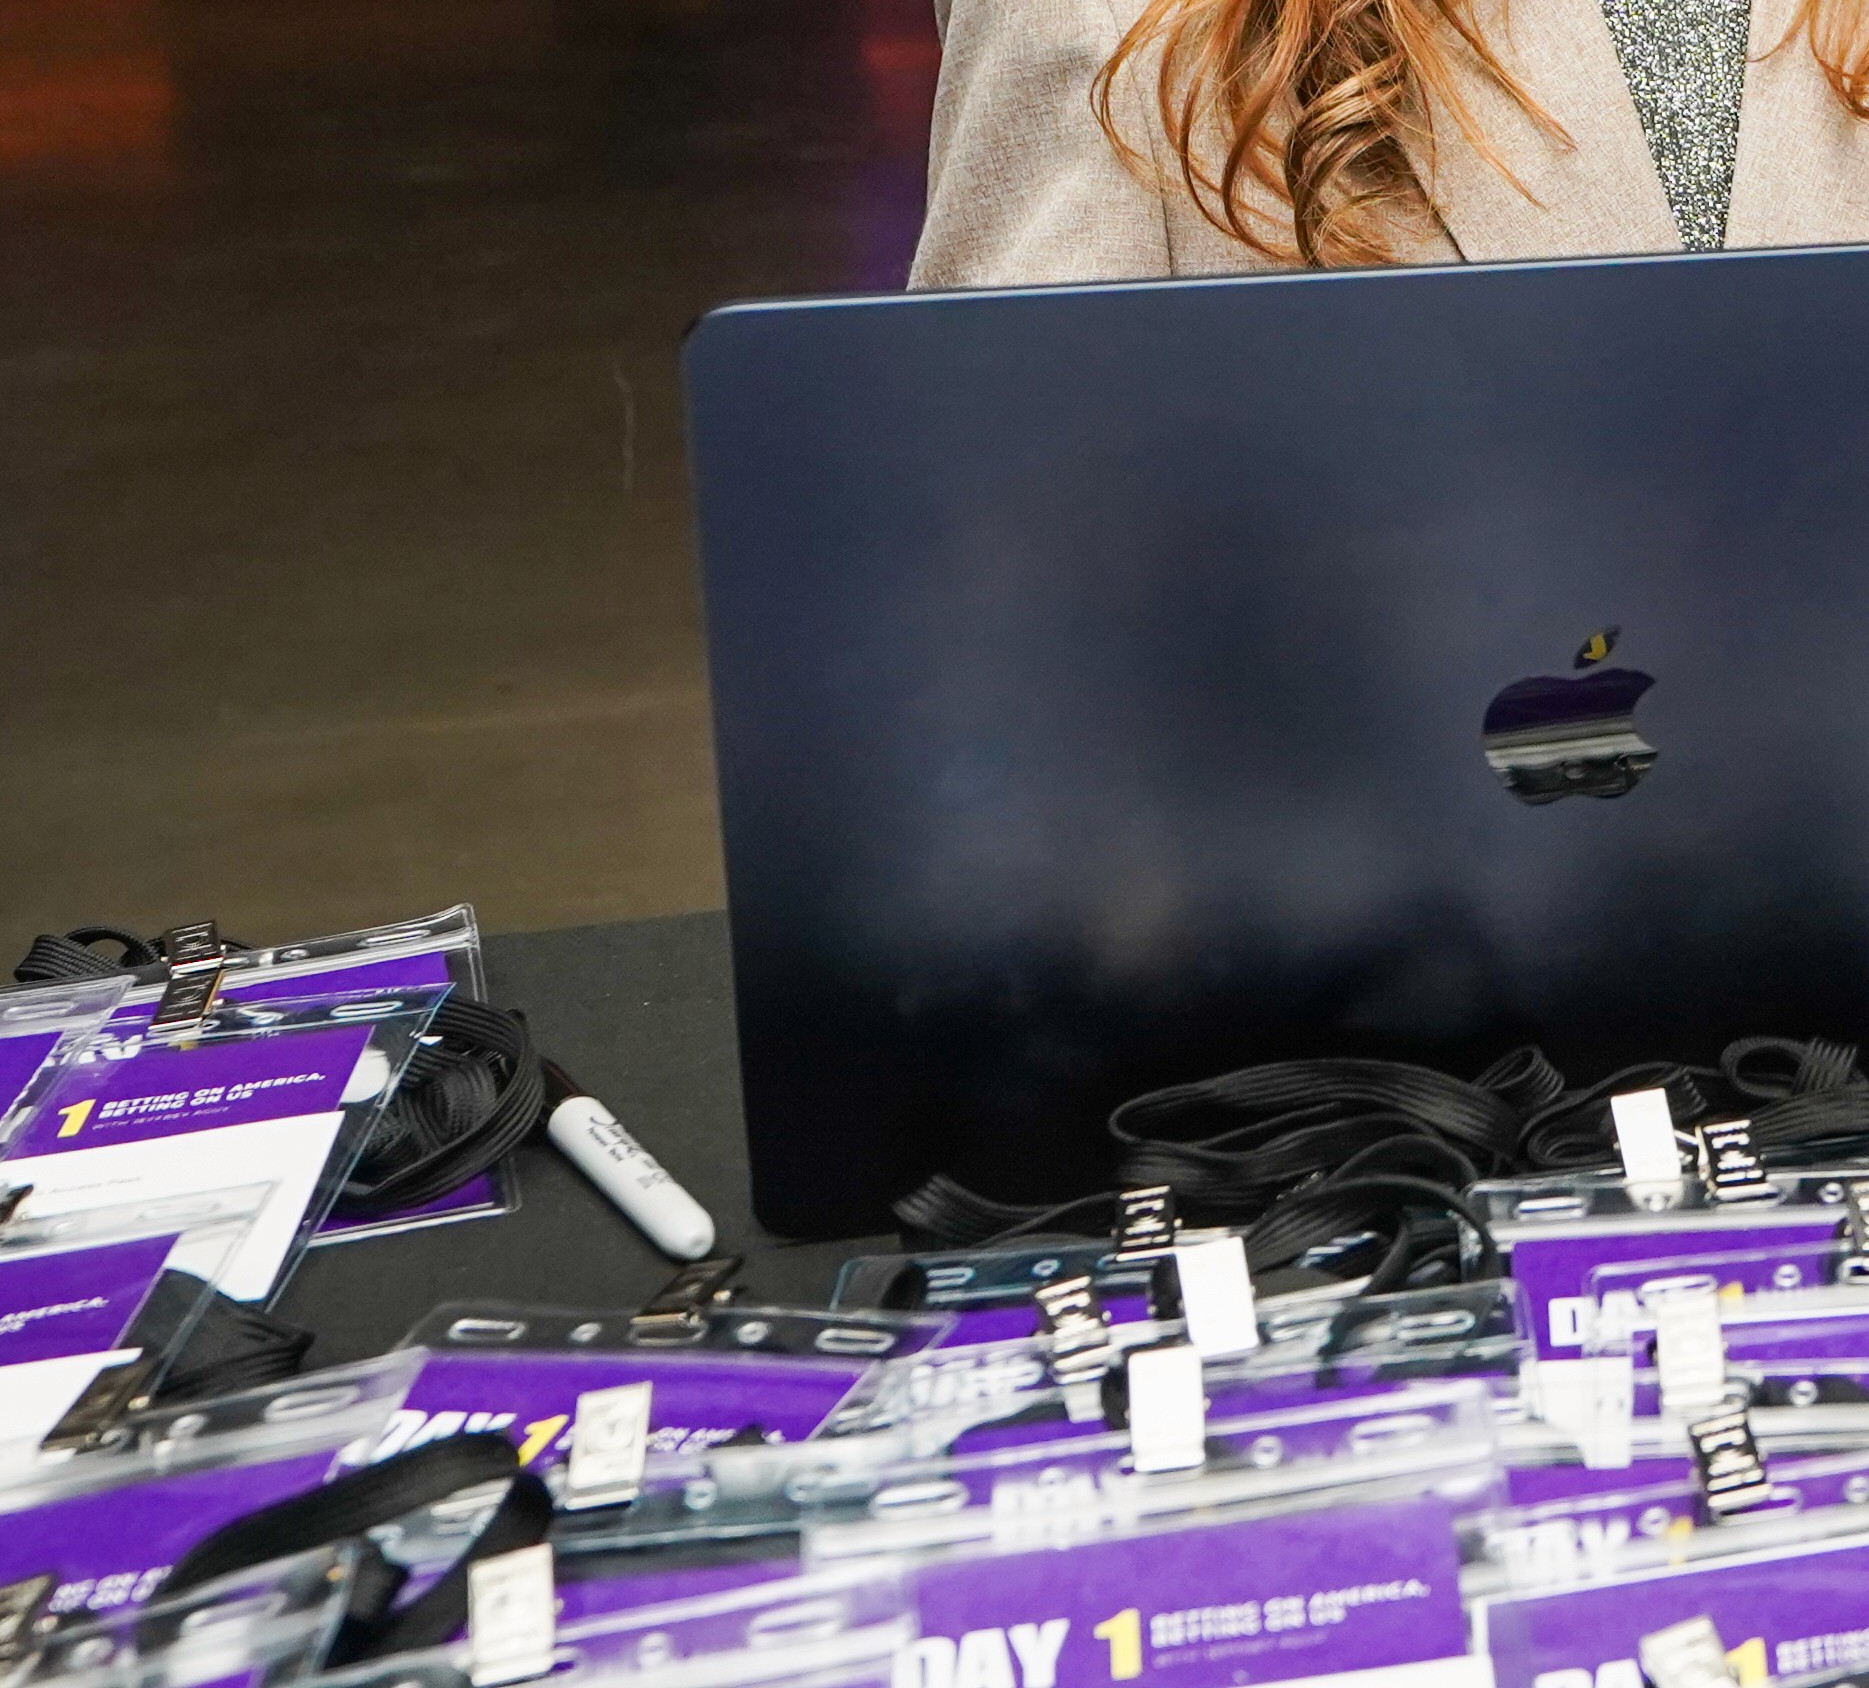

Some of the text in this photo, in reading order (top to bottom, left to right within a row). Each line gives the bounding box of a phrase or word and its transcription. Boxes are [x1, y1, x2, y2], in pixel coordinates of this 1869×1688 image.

[98, 1089, 255, 1119] BETTING ON US
[103, 1072, 326, 1110] BETTING ON AMERICA,
[57, 1099, 96, 1138] 1
[889, 1617, 1071, 1688] DAY
[1093, 1607, 1143, 1681] 1
